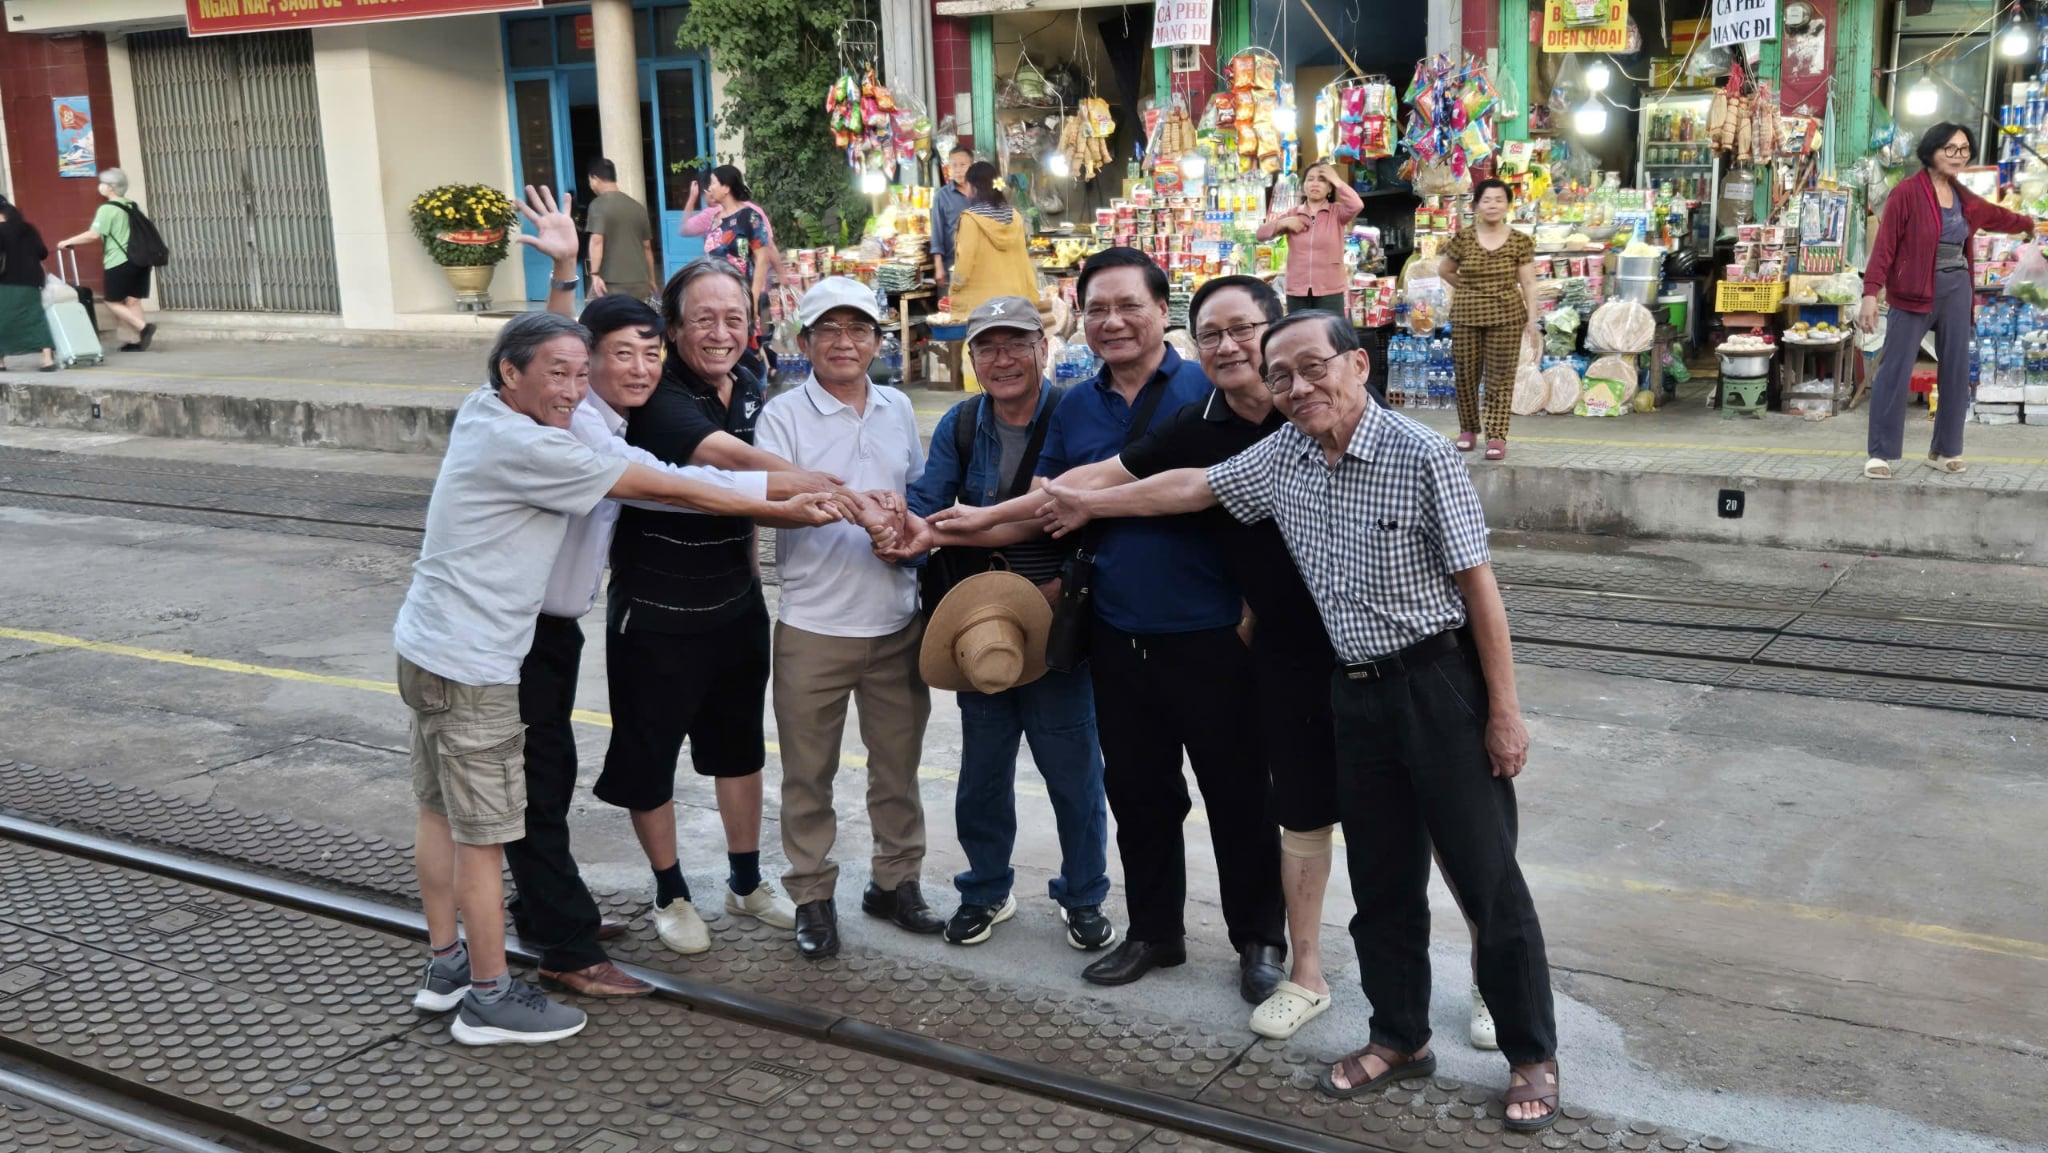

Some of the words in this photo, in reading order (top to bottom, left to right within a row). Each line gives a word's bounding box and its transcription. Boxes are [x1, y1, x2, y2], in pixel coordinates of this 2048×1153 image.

[1155, 24, 1187, 44] MANG
[1192, 23, 1208, 40] ĐI
[1548, 27, 1579, 49] ĐIỆN
[1583, 28, 1622, 49] THOẠI
[1712, 21, 1750, 44] MANG
[1754, 17, 1770, 37] ĐI
[1726, 499, 1738, 511] 20
